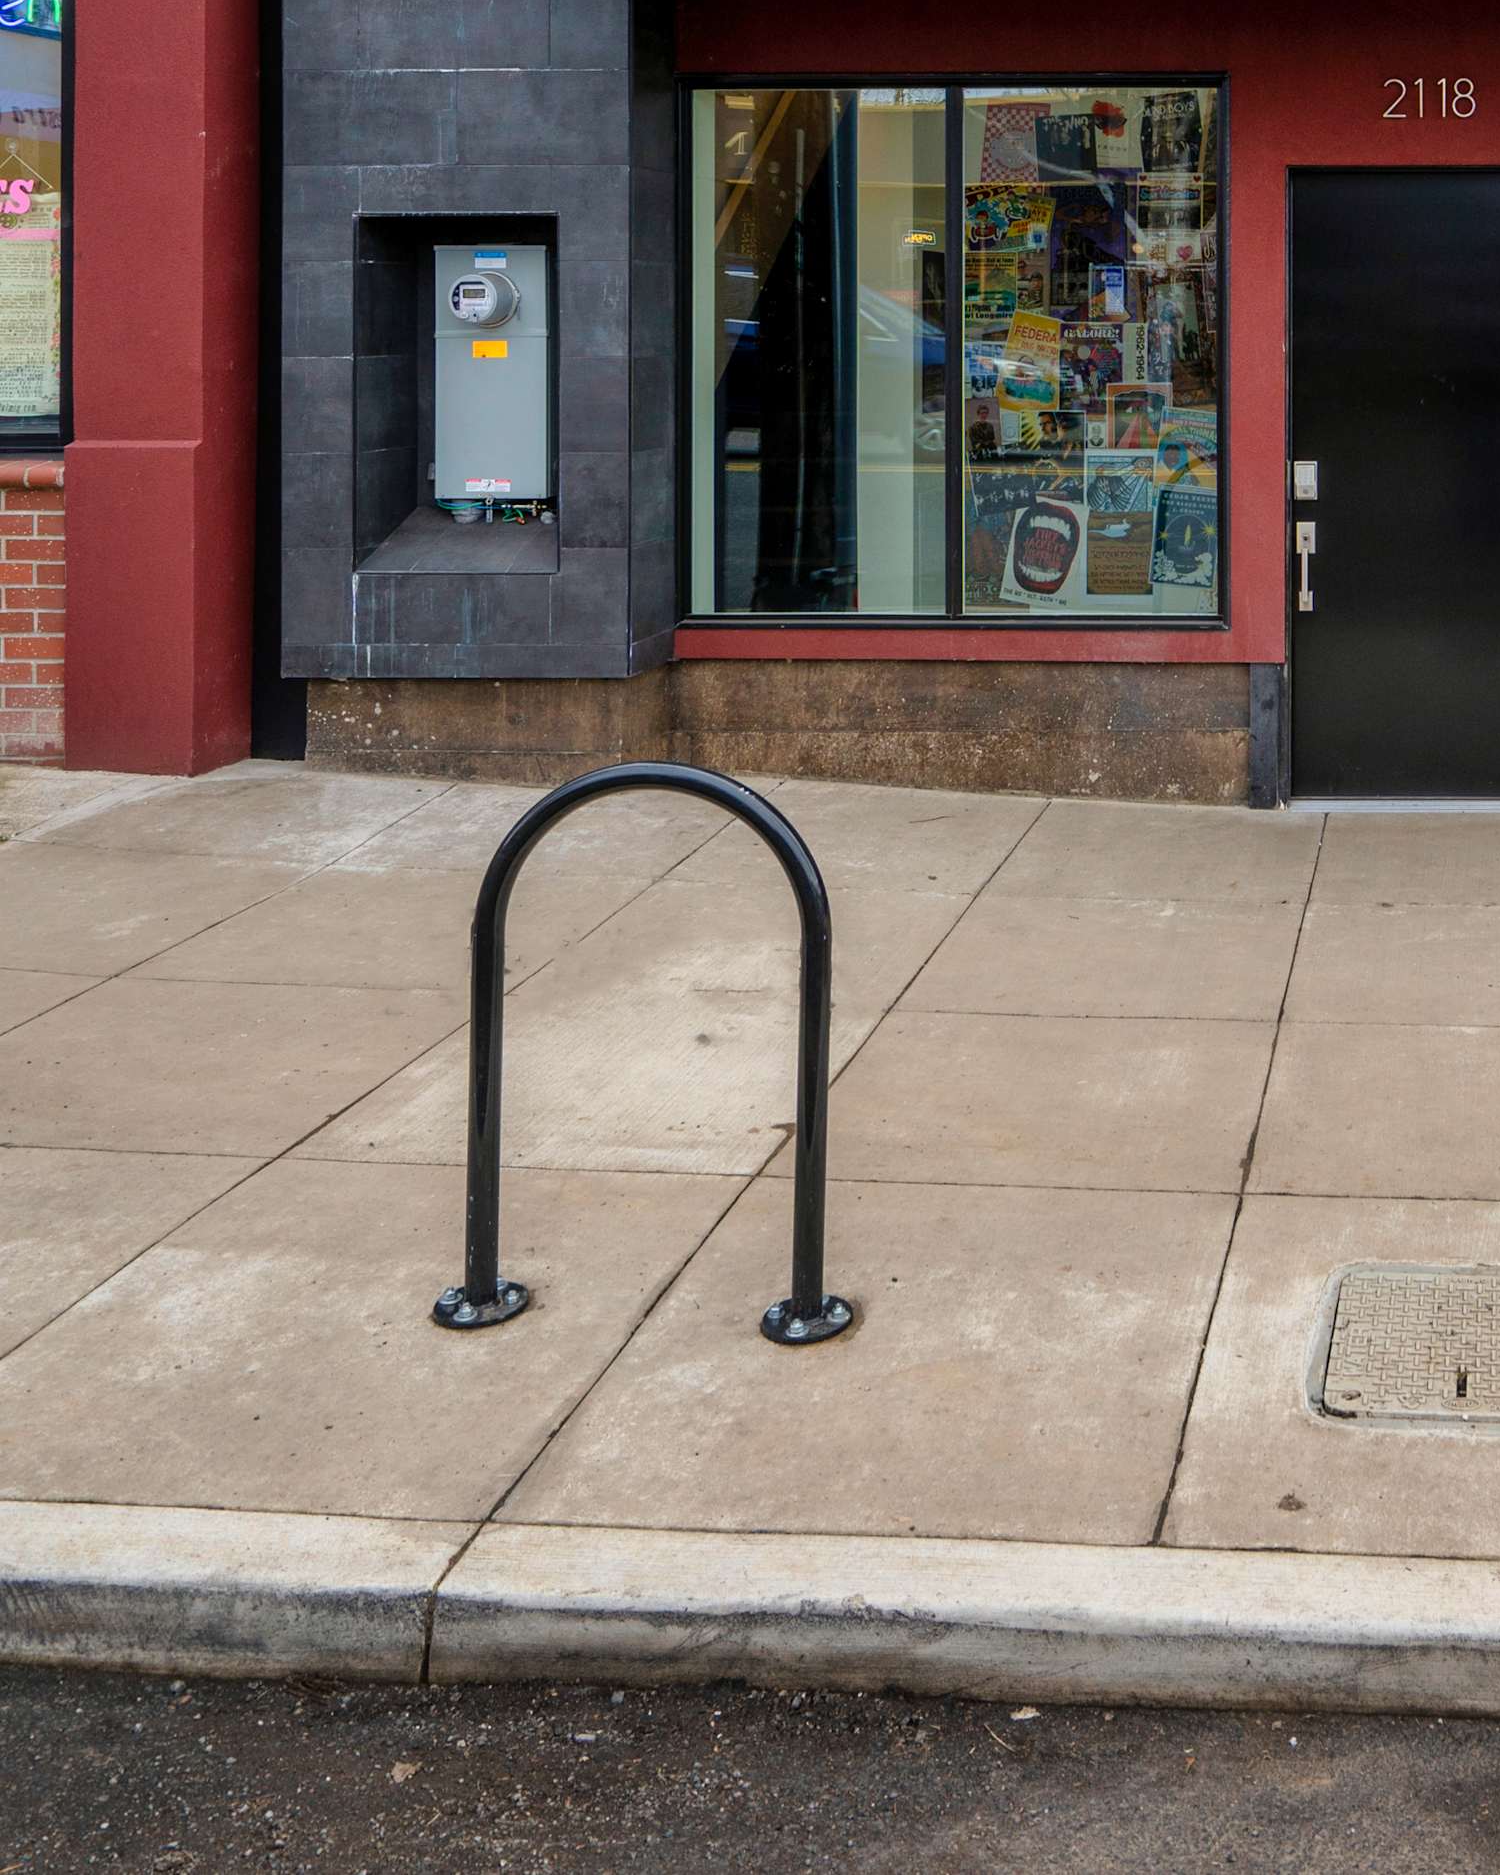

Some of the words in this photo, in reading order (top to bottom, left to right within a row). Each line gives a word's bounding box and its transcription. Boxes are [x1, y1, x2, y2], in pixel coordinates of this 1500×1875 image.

[1382, 77, 1476, 118] 2118
[1063, 328, 1120, 339] GALORE!
[1135, 324, 1145, 381] 1962-1964
